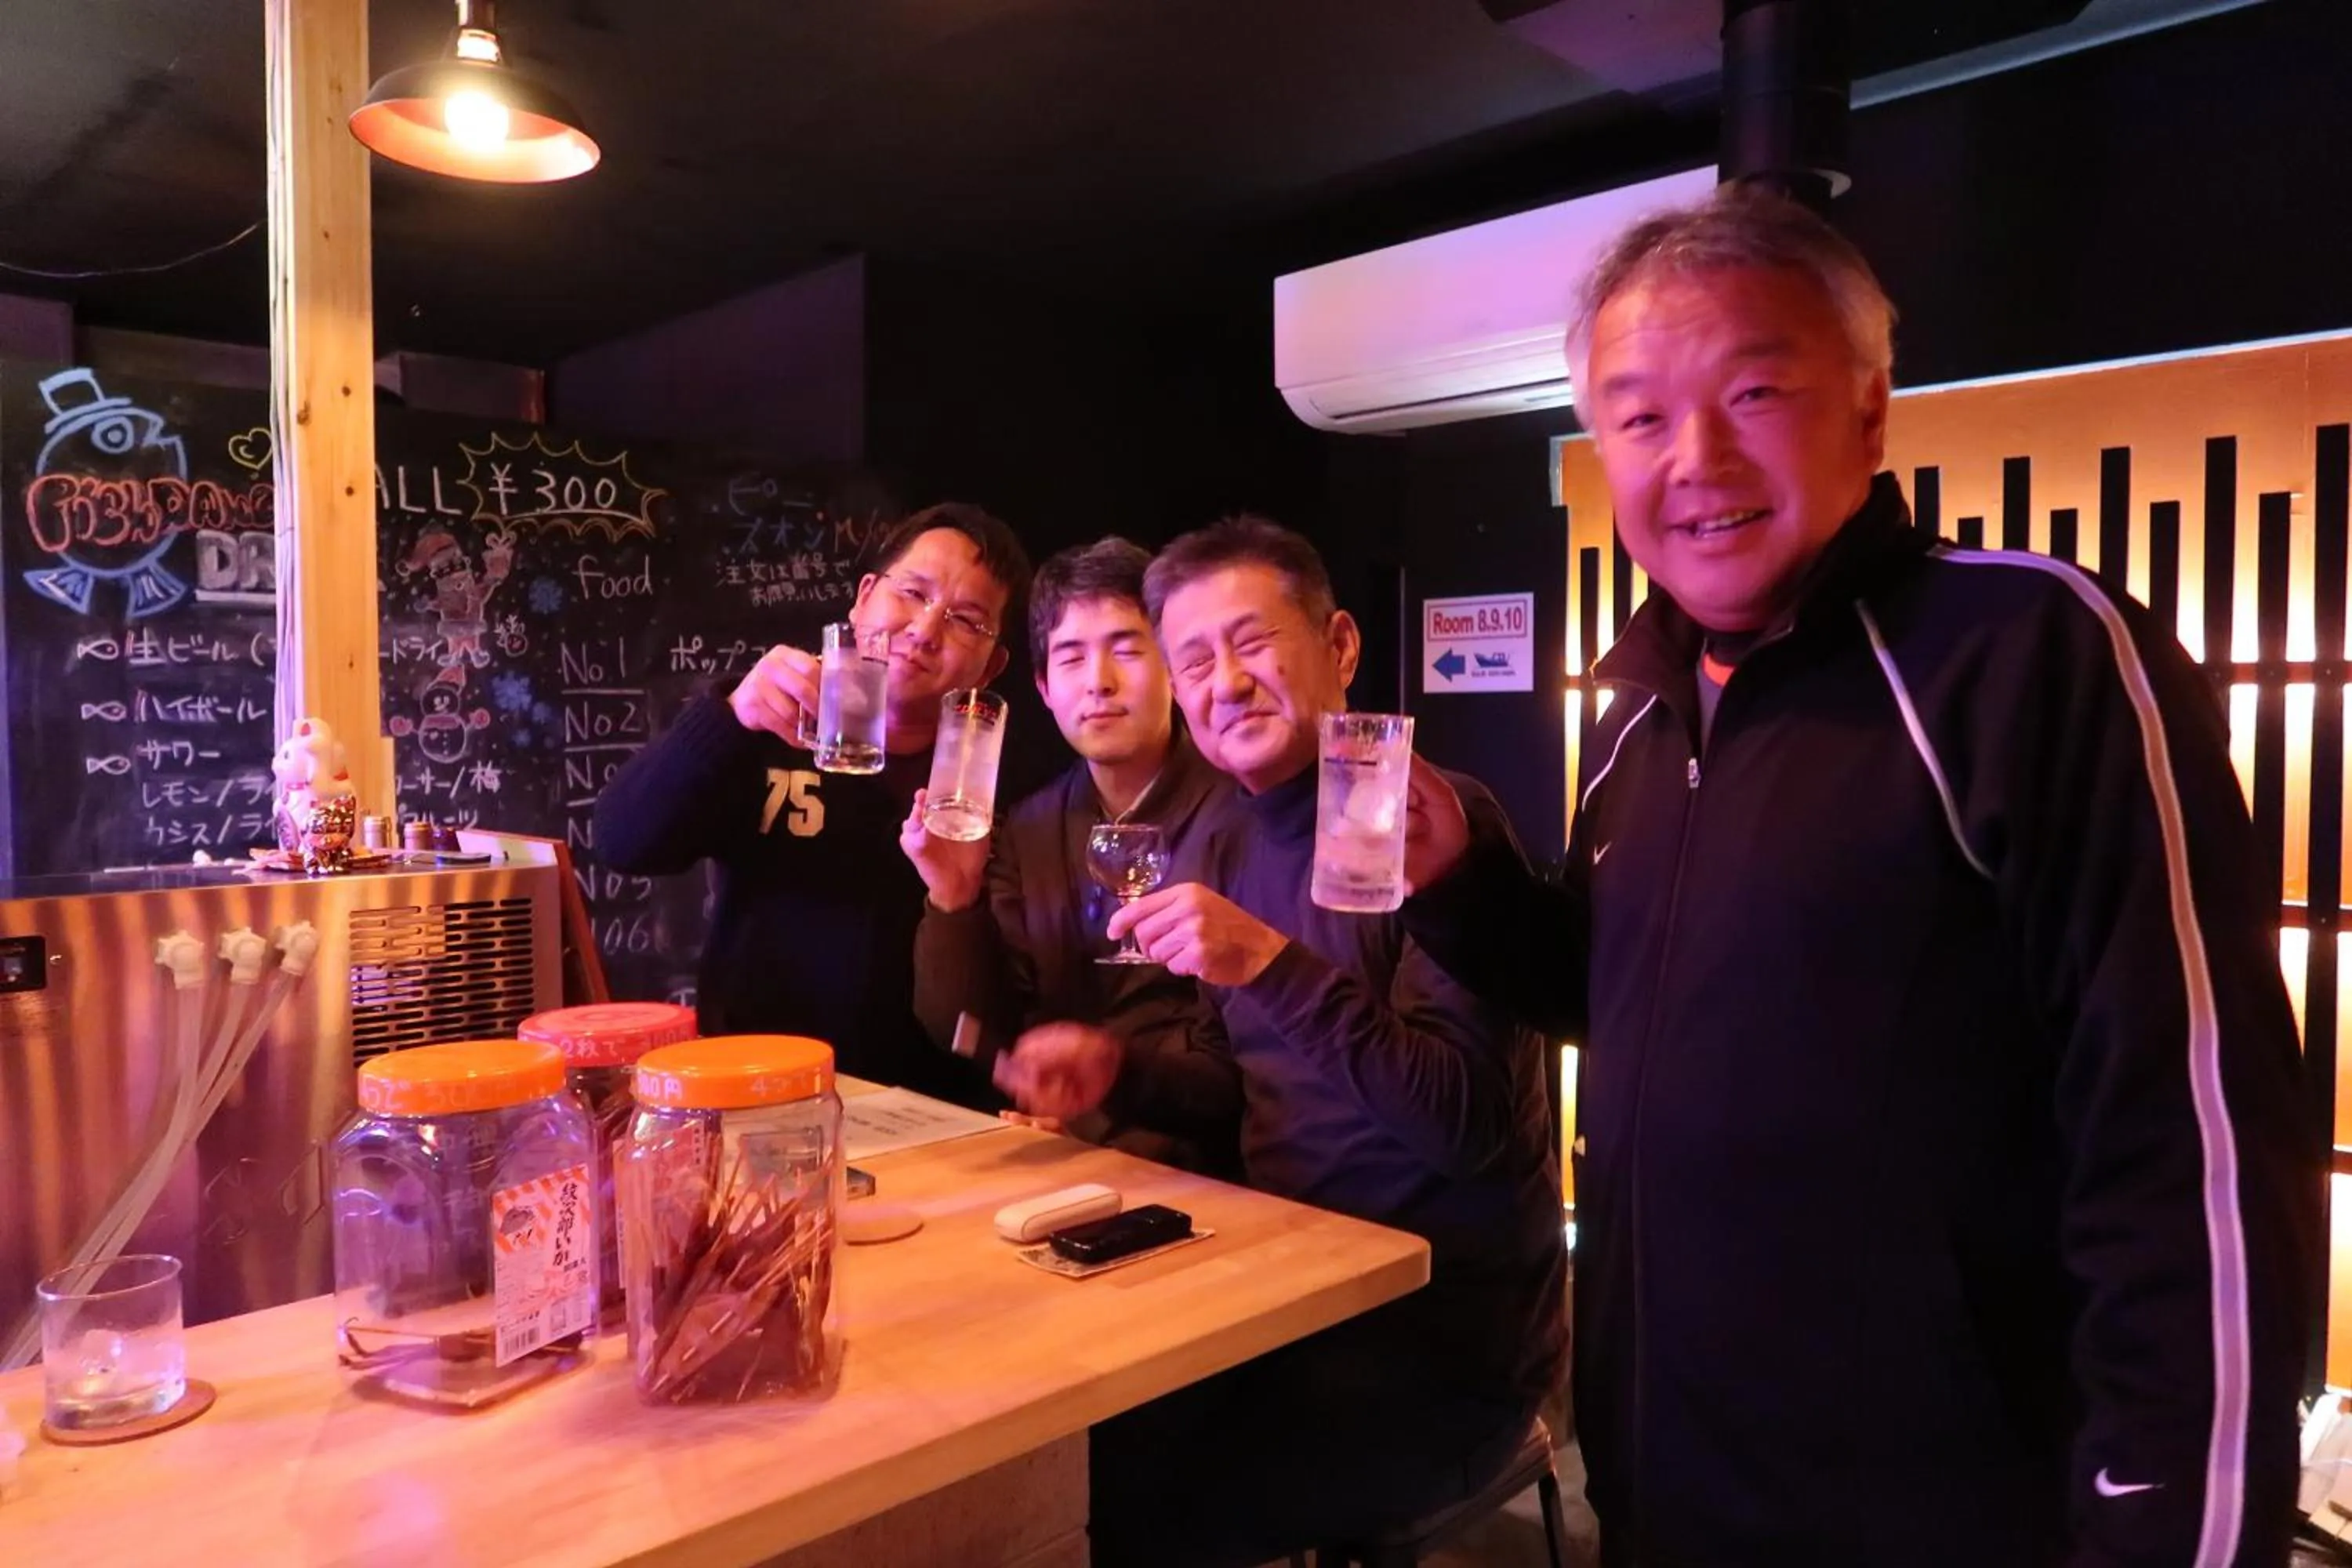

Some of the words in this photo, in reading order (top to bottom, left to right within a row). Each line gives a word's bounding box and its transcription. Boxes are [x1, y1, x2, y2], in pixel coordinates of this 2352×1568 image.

[488, 462, 618, 515] ¥300
[571, 555, 653, 600] food
[1433, 612, 1474, 634] Room
[1478, 606, 1523, 633] 8.9.10
[125, 627, 238, 665] 生ビール
[136, 688, 267, 723] ハイボール
[136, 739, 221, 769] サワー
[564, 754, 619, 789] No
[759, 768, 825, 837] 75
